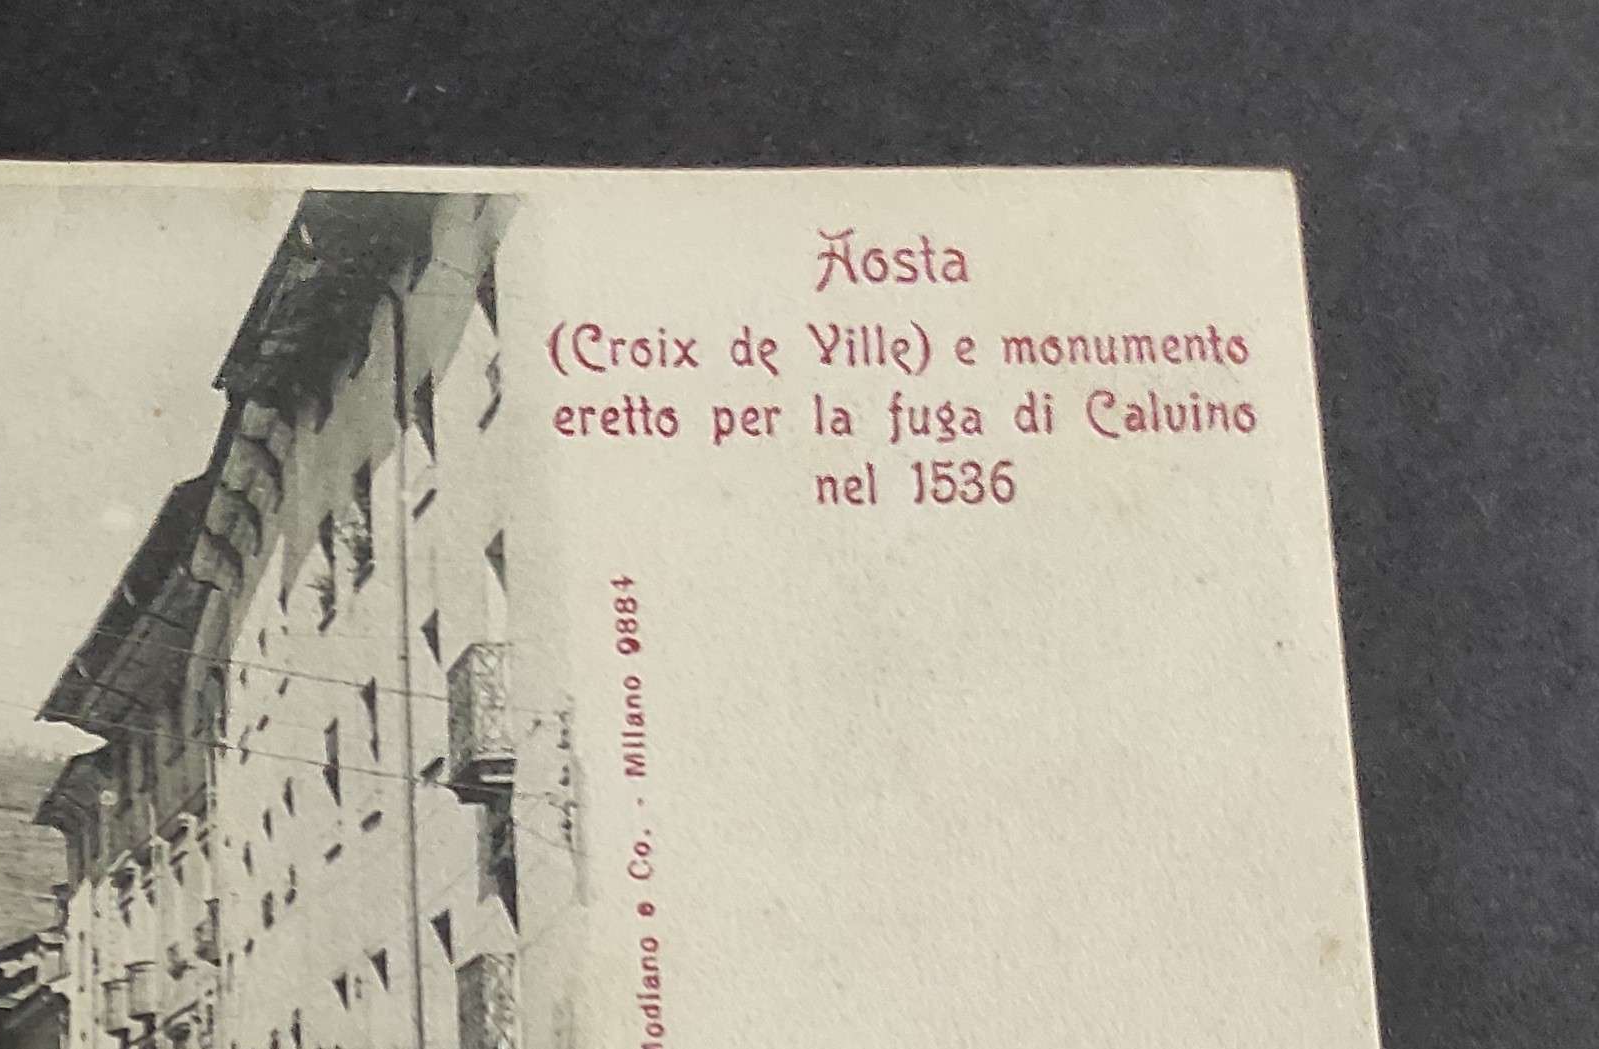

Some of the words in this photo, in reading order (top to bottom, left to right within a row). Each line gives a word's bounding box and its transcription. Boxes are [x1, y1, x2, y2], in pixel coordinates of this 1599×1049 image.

[815, 226, 971, 294] Aosta
[548, 322, 701, 376] (Croix
[730, 326, 781, 378] de
[807, 322, 934, 376] Ville)
[955, 336, 979, 368] e
[1003, 323, 1251, 369] monumento
[553, 394, 681, 441] eretto
[711, 403, 783, 447] per
[814, 394, 854, 438] la
[889, 390, 986, 447] fuga
[1014, 390, 1055, 436] di
[1084, 386, 1259, 441] Calvino
[817, 462, 879, 508] nel
[912, 458, 1016, 508] 1536
[622, 673, 648, 780] Milano
[626, 828, 653, 882] Co.
